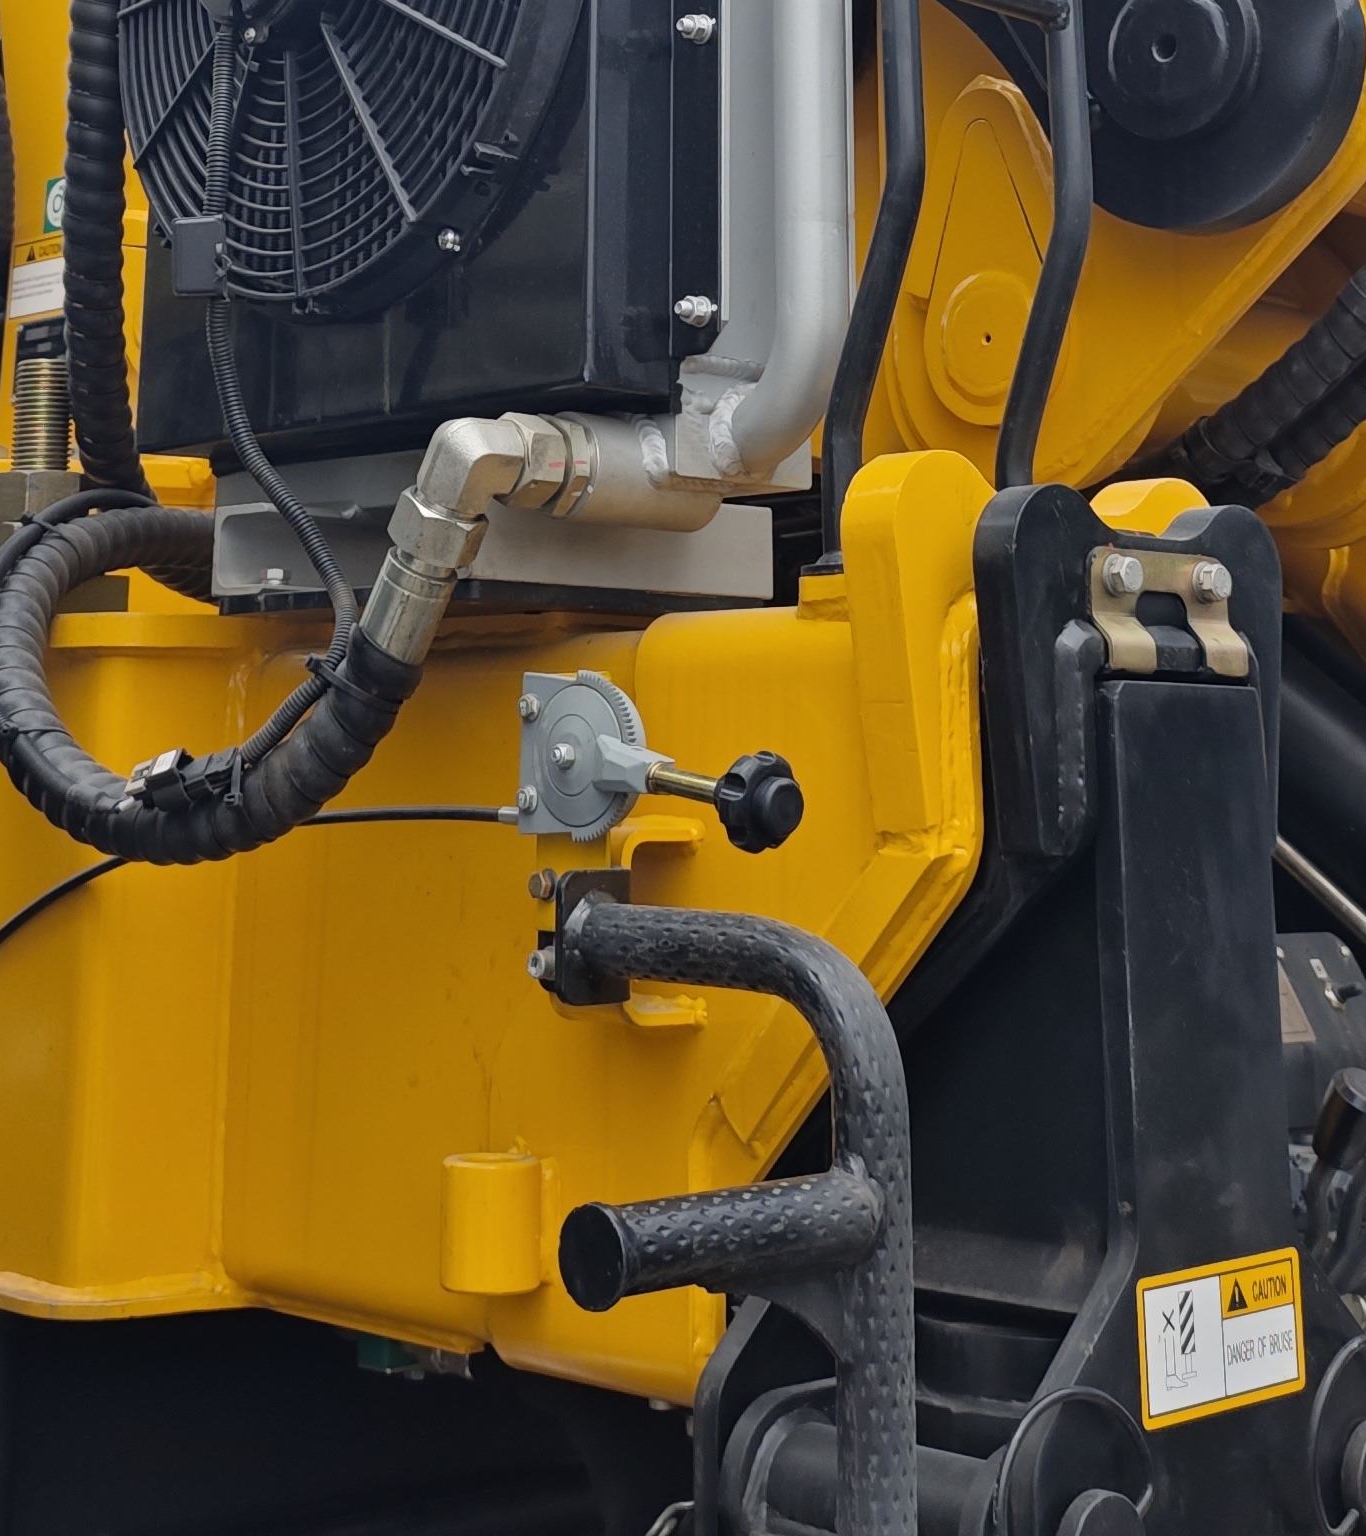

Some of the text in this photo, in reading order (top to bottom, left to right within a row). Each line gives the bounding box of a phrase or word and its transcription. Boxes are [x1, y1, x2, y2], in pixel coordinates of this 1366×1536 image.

[1251, 1274, 1287, 1302] CAUTION
[1226, 1329, 1294, 1366] DANGER OF BRUISE
